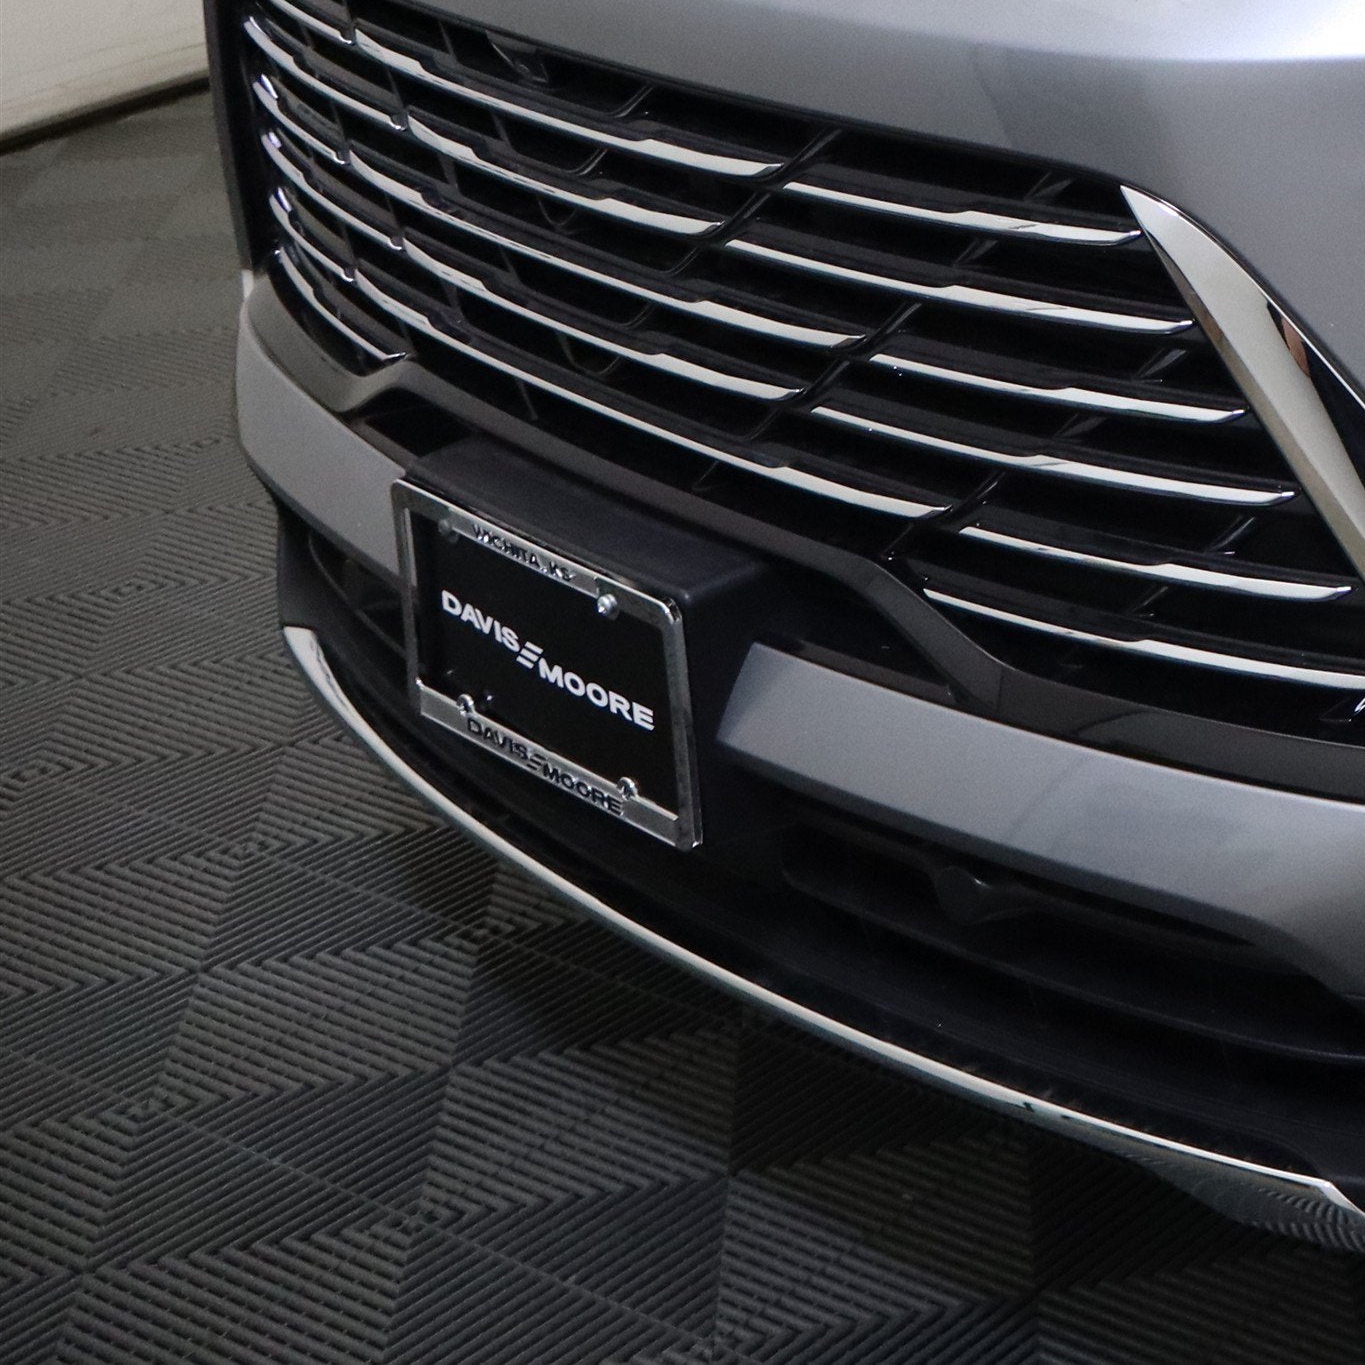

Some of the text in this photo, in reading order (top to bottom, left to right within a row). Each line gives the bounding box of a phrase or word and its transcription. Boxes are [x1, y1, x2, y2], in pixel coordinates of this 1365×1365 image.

[441, 589, 656, 732] DAVIS MOORE
[466, 717, 626, 817] DAVIS MOORE
